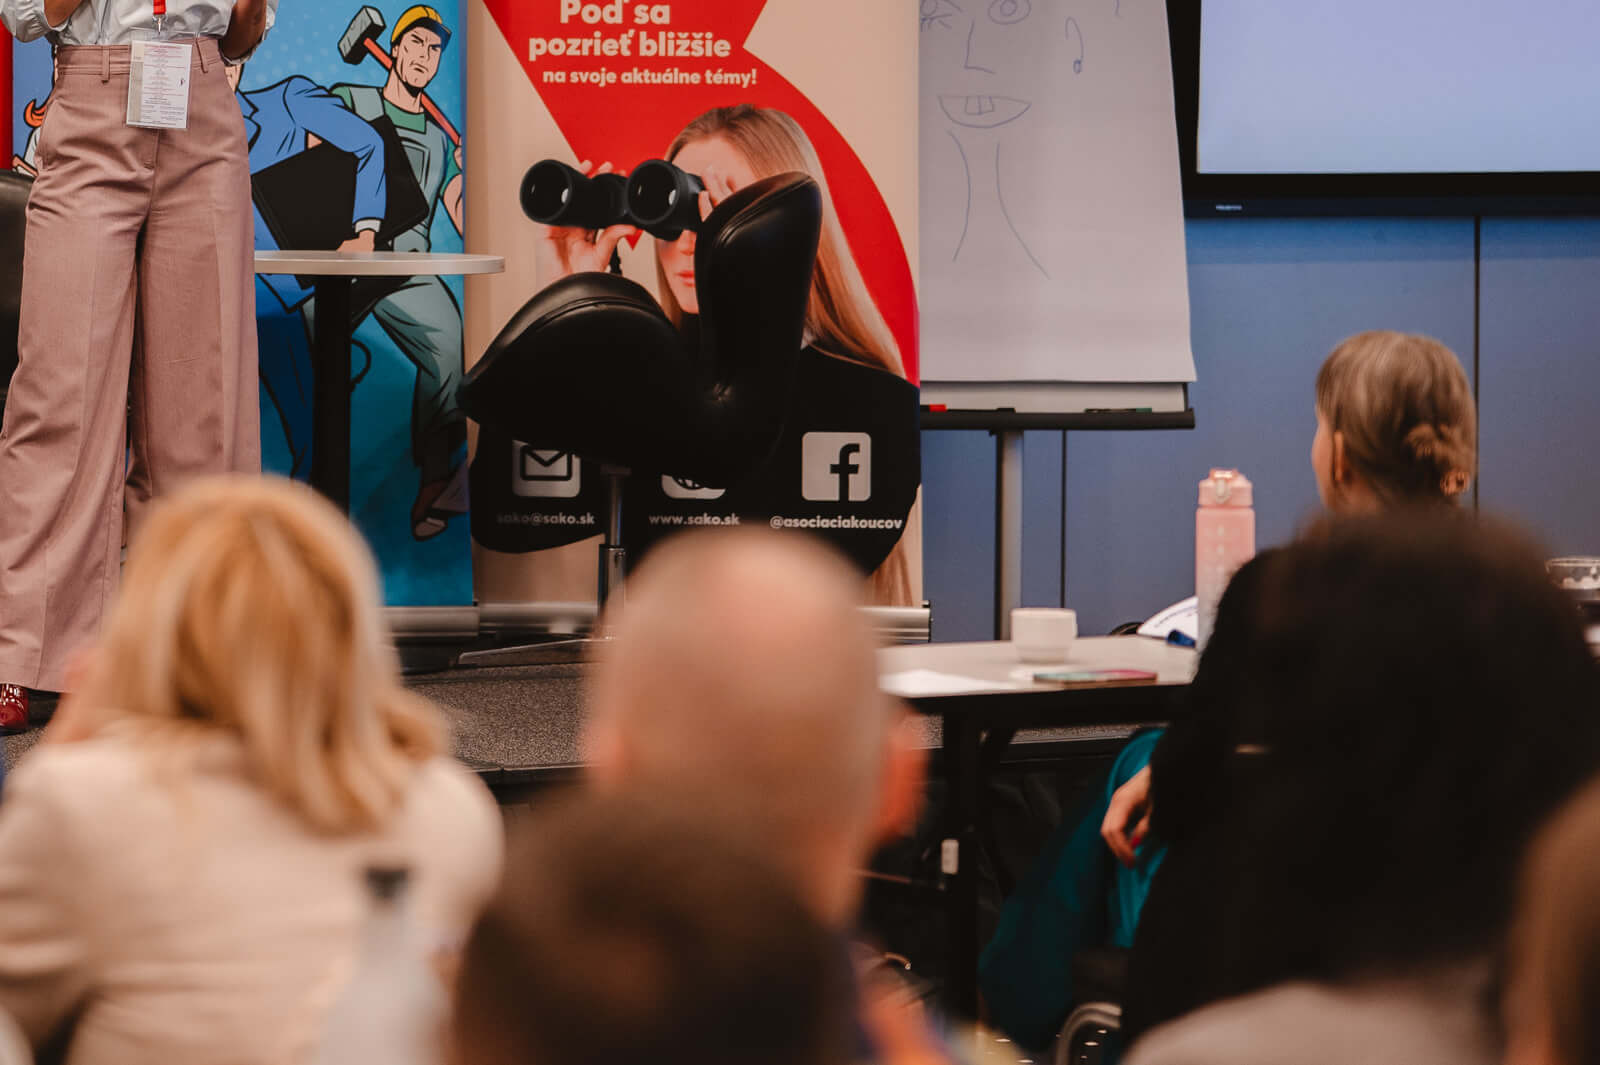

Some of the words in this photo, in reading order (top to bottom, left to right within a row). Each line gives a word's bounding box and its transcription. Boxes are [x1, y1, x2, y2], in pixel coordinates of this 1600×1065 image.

[633, 0, 671, 26] sa
[528, 28, 638, 62] pozrieť
[638, 31, 732, 59] bližšie
[542, 70, 567, 84] na
[569, 68, 617, 88] svoje
[620, 67, 702, 86] aktuálne
[704, 68, 758, 89] témy!
[648, 512, 741, 527] www.sako.sk
[769, 513, 903, 531] @asociaciakoucov
